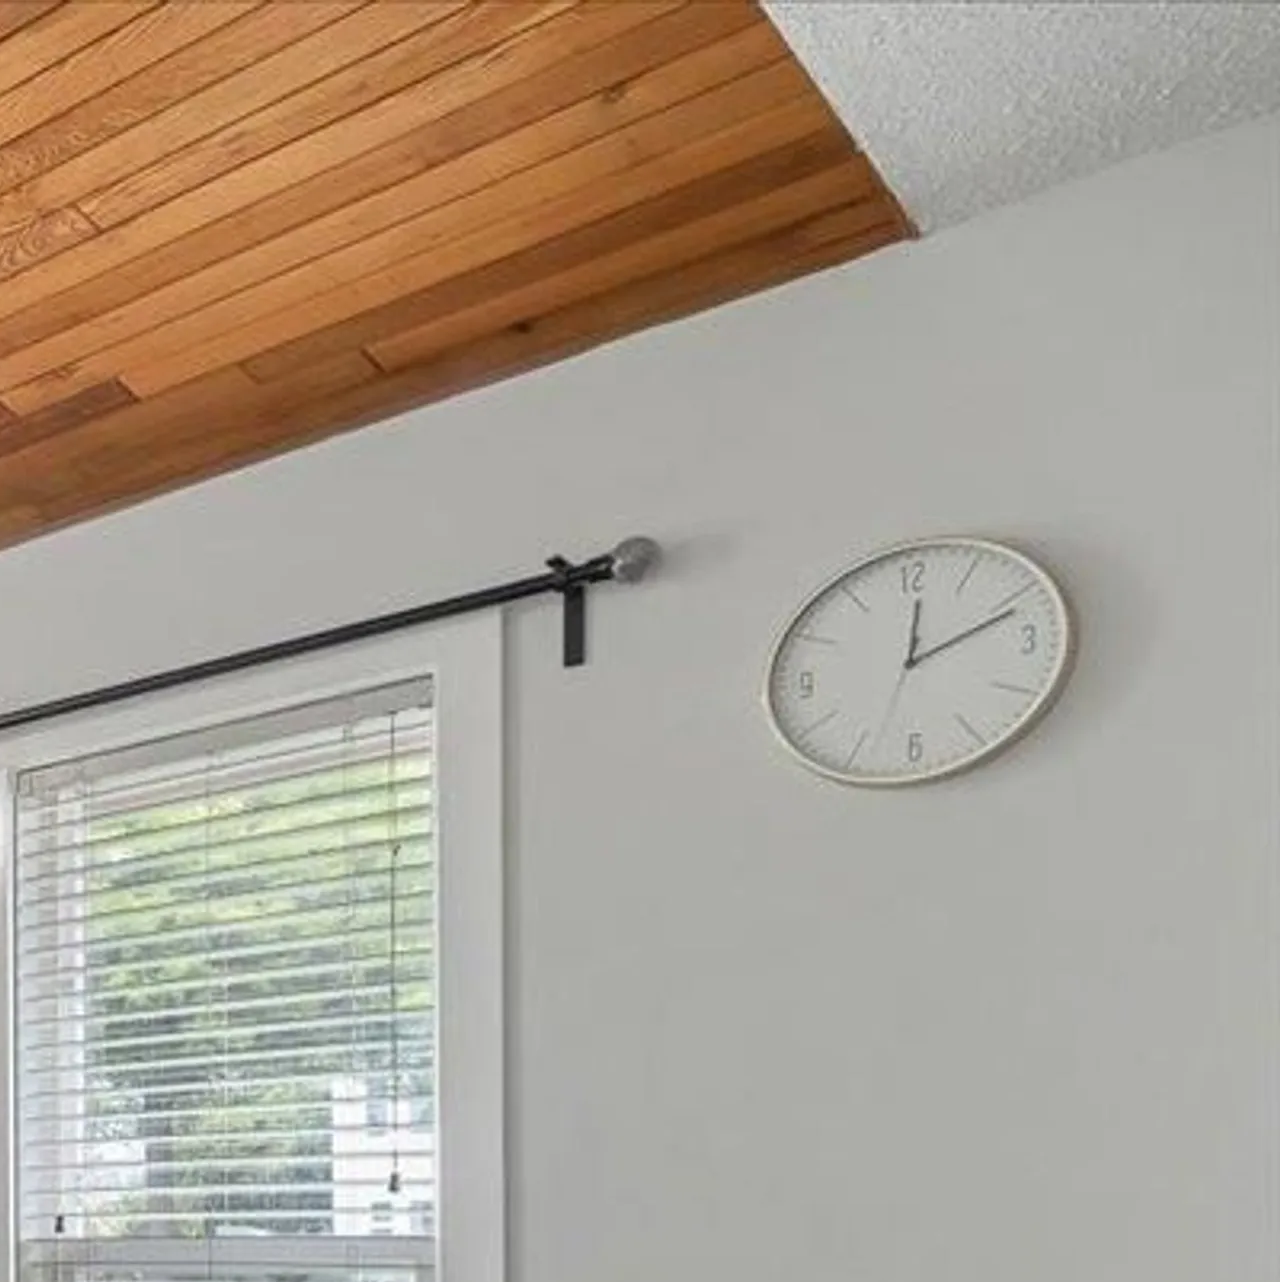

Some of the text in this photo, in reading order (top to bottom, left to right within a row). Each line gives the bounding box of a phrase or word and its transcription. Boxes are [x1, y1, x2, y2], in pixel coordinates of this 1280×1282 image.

[900, 561, 925, 594] 12
[1021, 624, 1036, 654] 3
[799, 671, 814, 698] 9
[908, 732, 923, 762] 6
